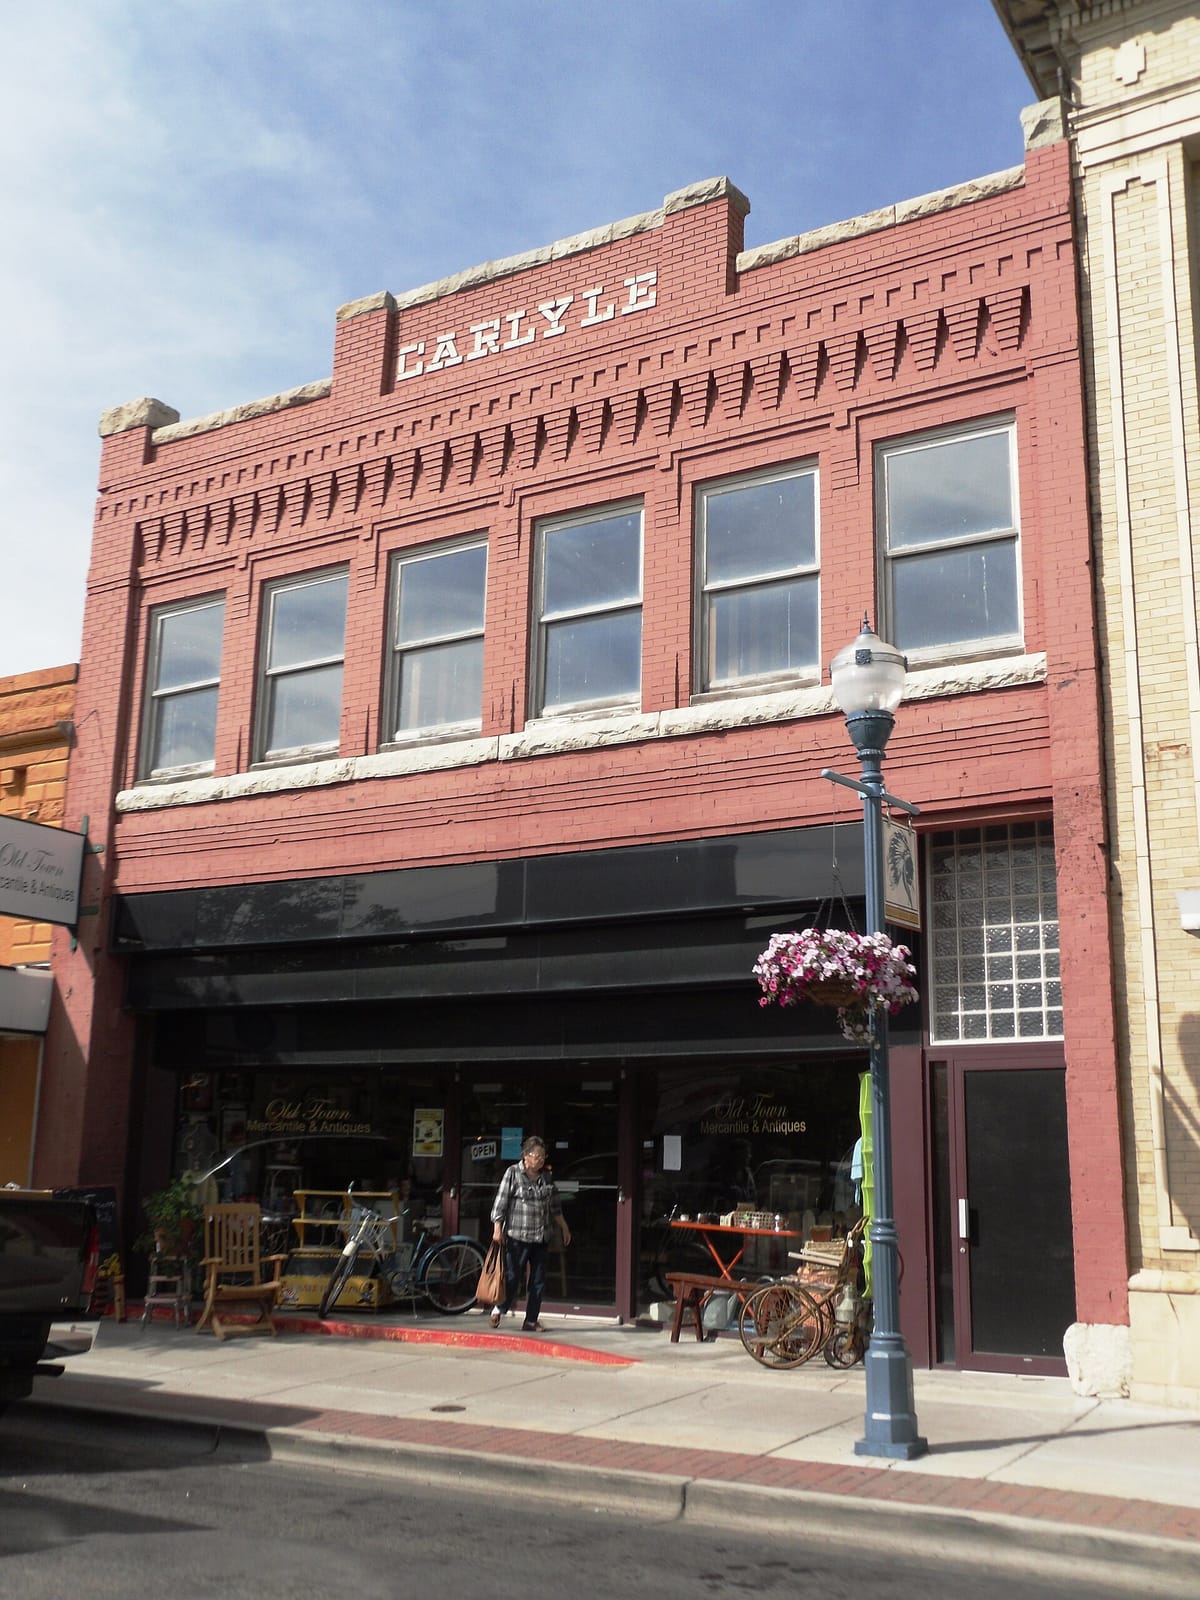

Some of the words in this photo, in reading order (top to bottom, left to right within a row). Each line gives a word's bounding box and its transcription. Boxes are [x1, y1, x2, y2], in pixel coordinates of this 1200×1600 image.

[397, 271, 658, 381] CARLYLE
[0, 843, 28, 867] Old
[28, 849, 64, 876] Town
[31, 879, 37, 894] &
[39, 881, 75, 902] Antiques
[264, 1097, 303, 1120] Old
[303, 1097, 352, 1120] Town
[714, 1095, 745, 1119] Old
[745, 1092, 787, 1118] Town
[246, 1119, 306, 1132] Mercantile
[308, 1120, 319, 1132] &
[319, 1121, 371, 1135] Antiques
[700, 1120, 750, 1133] Mercantile
[752, 1120, 760, 1133] &
[762, 1120, 807, 1136] Antiques
[472, 1142, 495, 1158] OPEN
